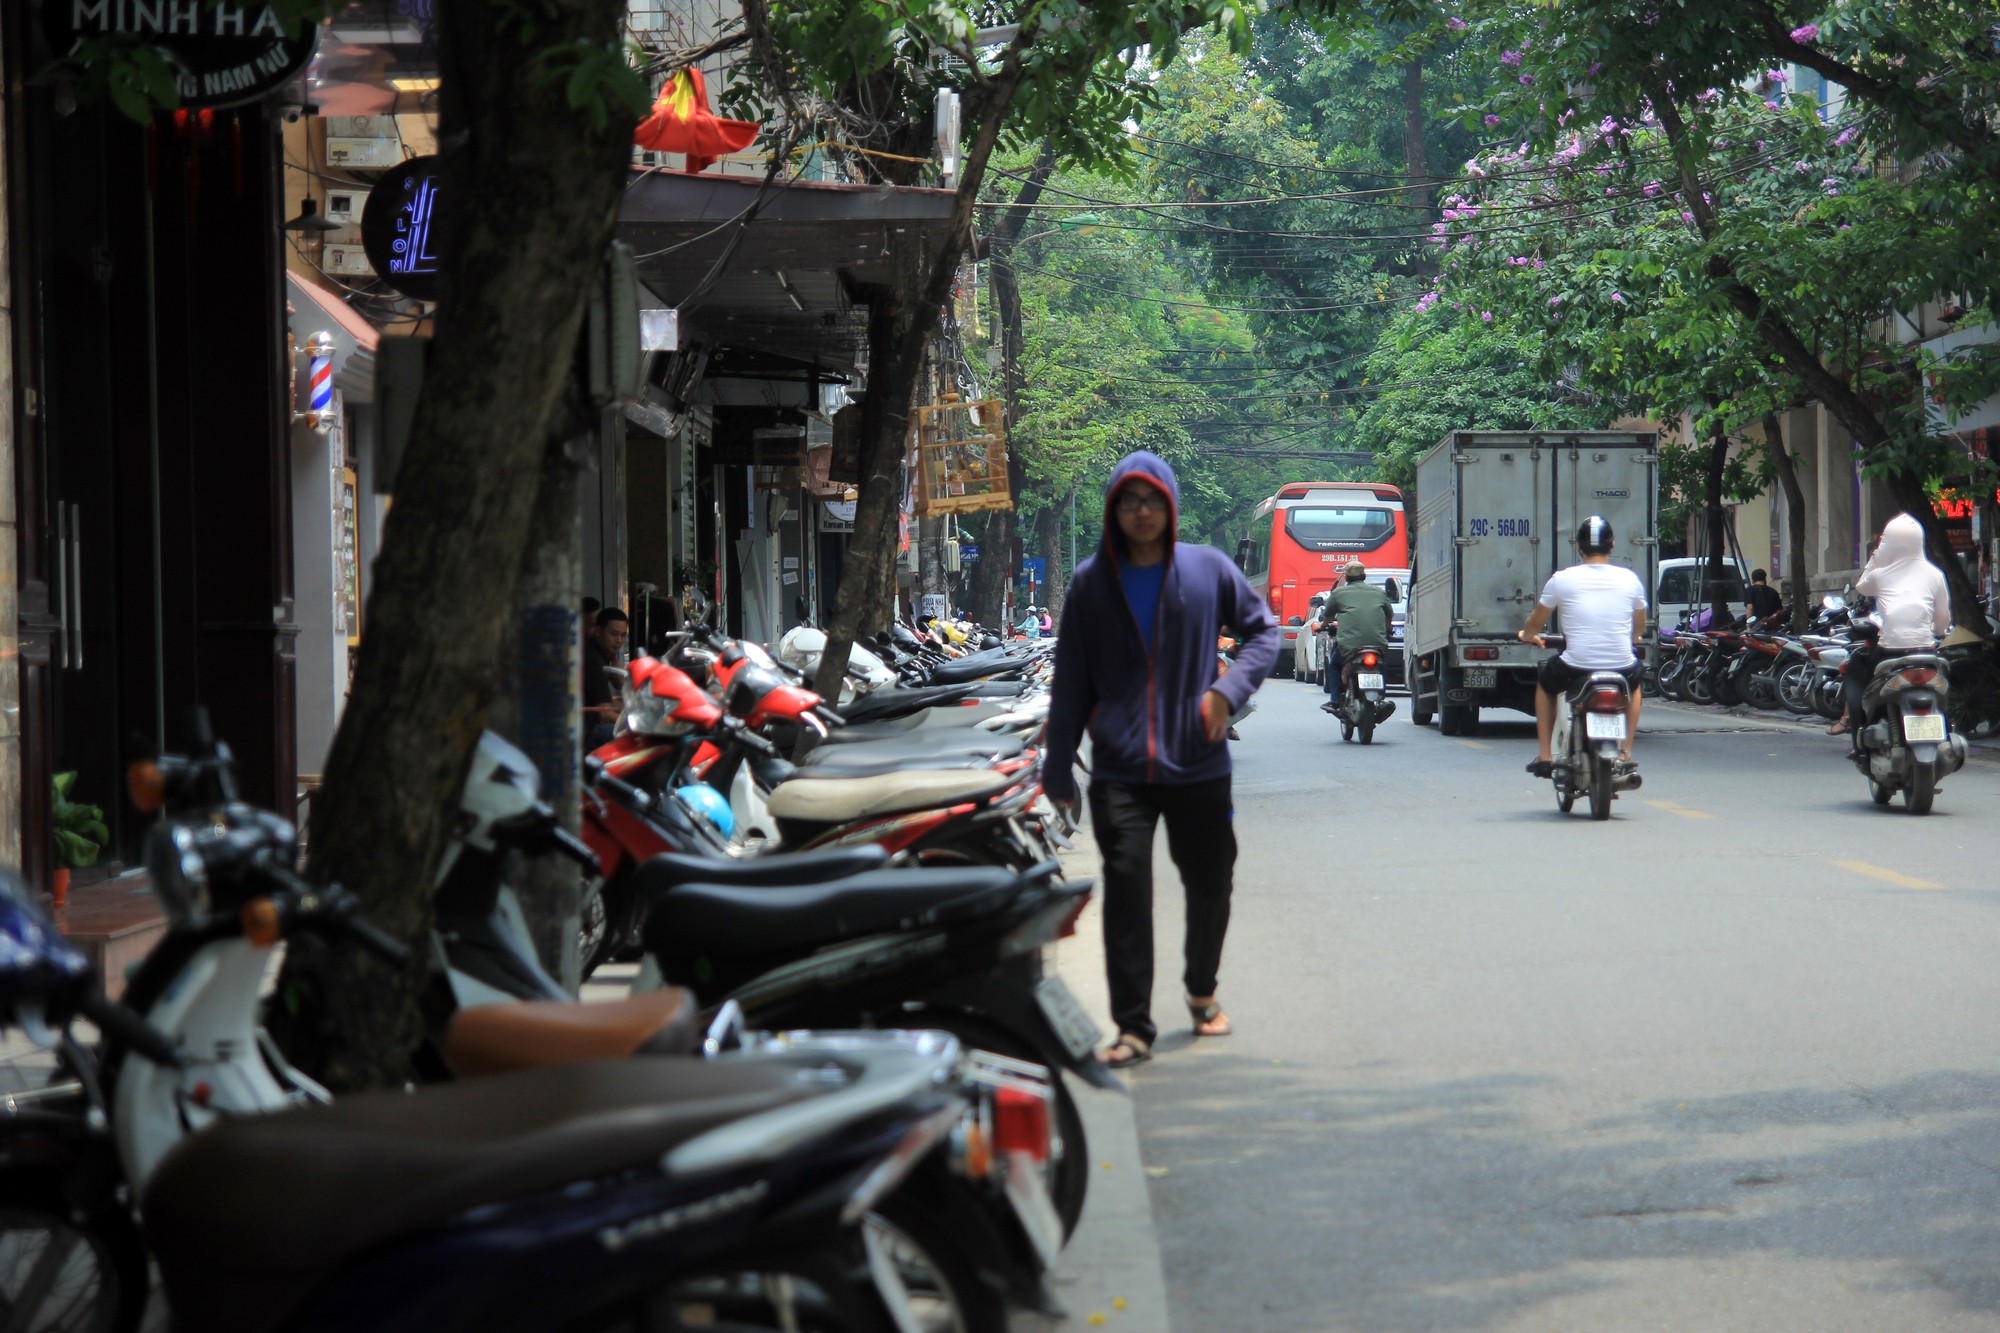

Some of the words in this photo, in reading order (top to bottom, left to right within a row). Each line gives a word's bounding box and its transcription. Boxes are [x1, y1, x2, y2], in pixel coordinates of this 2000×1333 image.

[72, 0, 199, 35] MINH
[204, 63, 257, 96] NAM
[823, 520, 844, 529] Korean
[1470, 518, 1488, 537] 29C
[1497, 518, 1530, 537] 569.00
